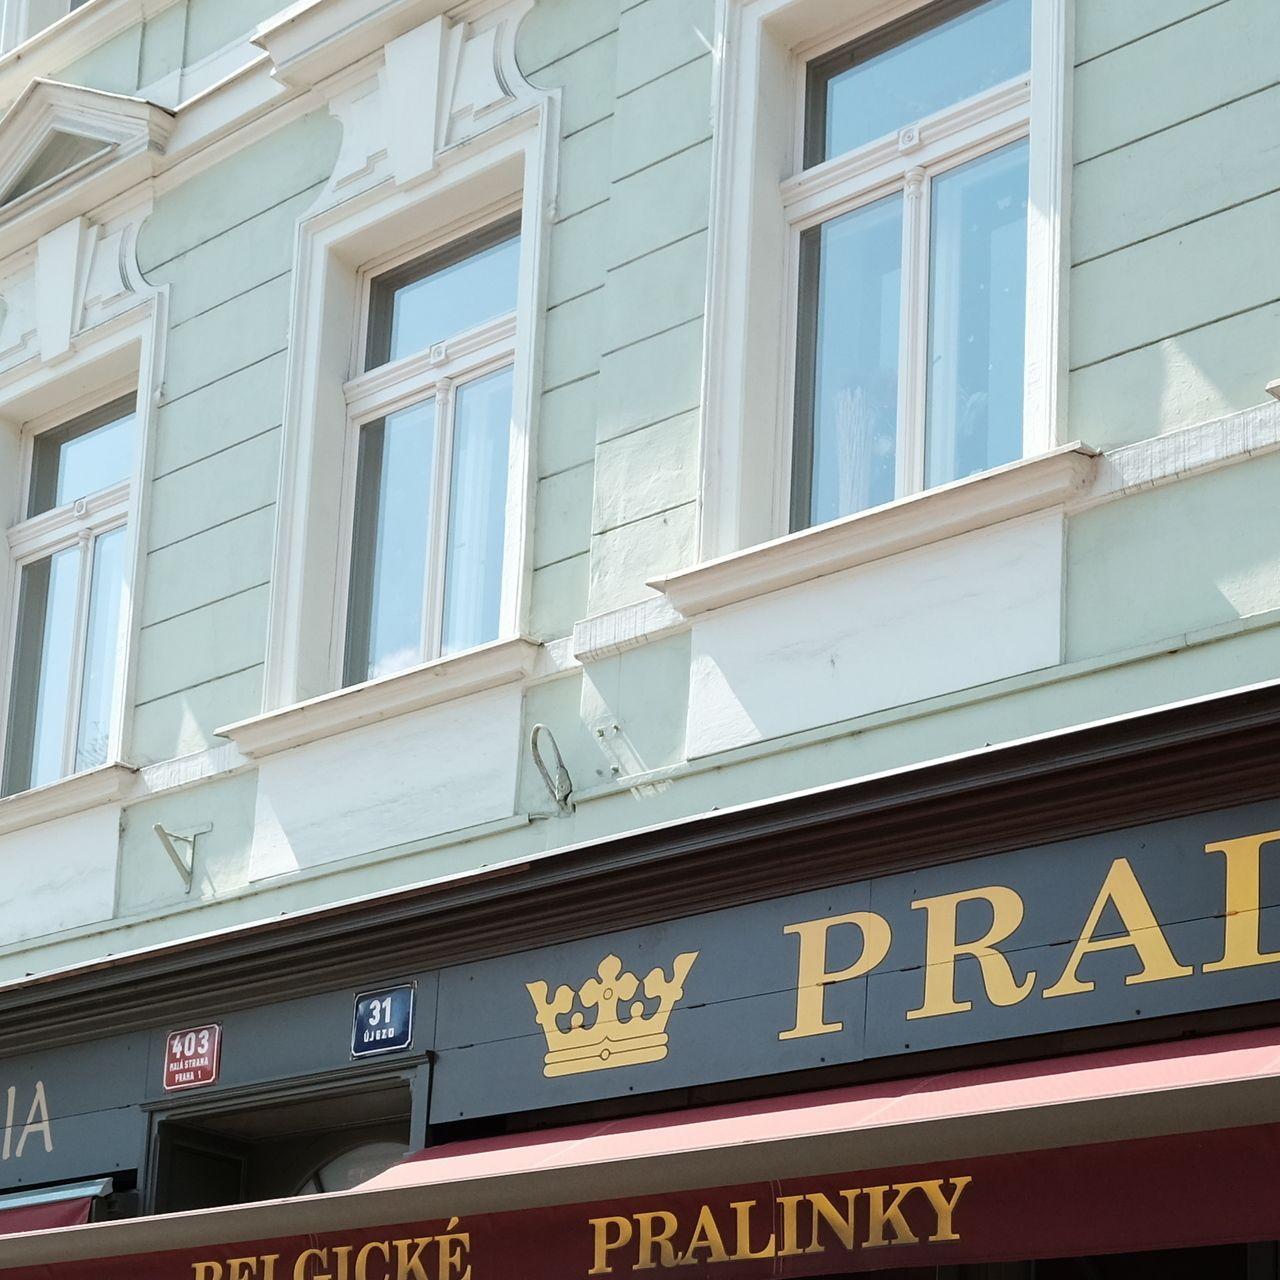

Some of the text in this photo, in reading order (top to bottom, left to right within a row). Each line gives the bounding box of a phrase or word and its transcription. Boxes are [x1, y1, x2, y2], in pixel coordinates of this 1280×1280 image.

[368, 996, 392, 1026] 31
[172, 1029, 210, 1059] 403
[363, 1027, 395, 1043] ÚJEZD
[587, 1175, 973, 1276] PRALINKY
